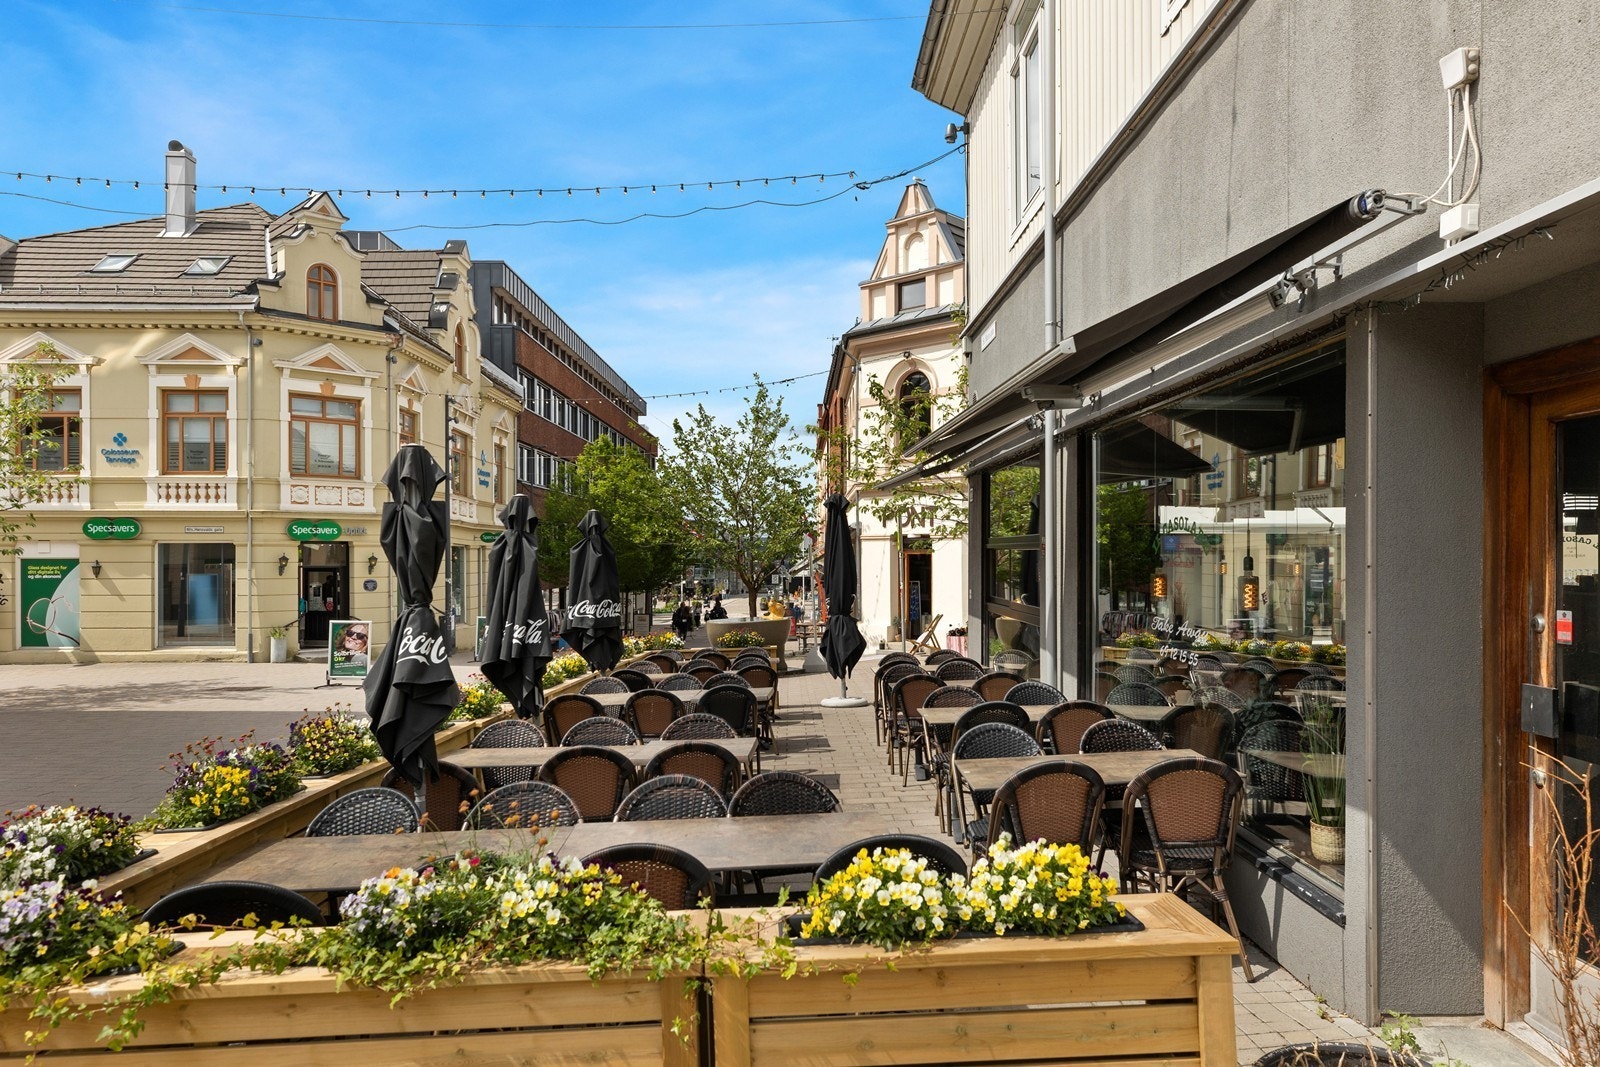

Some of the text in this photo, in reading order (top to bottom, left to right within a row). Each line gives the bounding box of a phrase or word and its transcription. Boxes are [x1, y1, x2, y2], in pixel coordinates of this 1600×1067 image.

[105, 456, 136, 464] Tannlege
[87, 523, 135, 534] Specsavers
[292, 525, 338, 535] Specsavers
[1151, 616, 1174, 634] Take
[1169, 647, 1178, 660] 12
[1179, 650, 1187, 663] 15
[1188, 653, 1199, 666] 55
